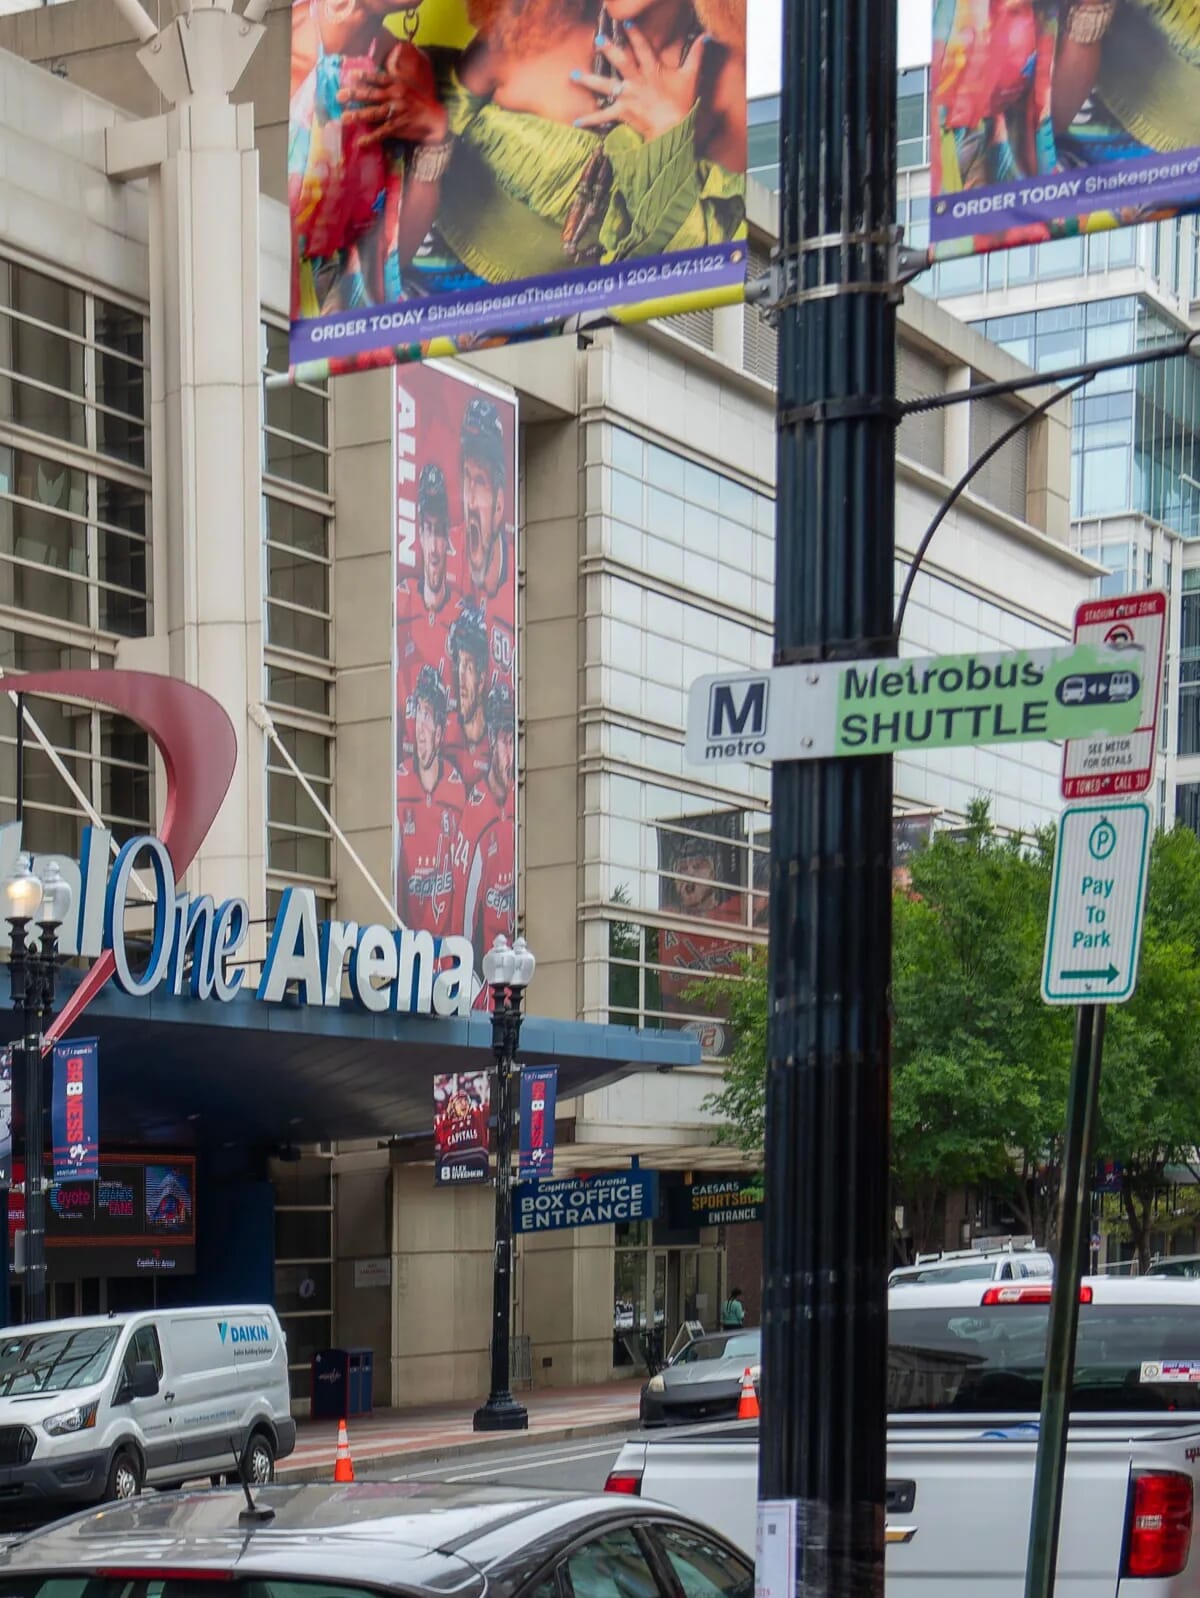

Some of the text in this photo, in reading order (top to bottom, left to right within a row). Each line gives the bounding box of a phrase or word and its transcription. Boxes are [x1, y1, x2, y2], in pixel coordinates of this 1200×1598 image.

[952, 193, 1016, 219] ORDER
[1019, 179, 1081, 205] TODAY
[1084, 156, 1200, 195] Shakespeare
[310, 317, 367, 344] ORDER
[369, 306, 426, 335] TODAY
[426, 275, 615, 324] ShakespeareTheatre.org
[398, 384, 416, 568] ALL IN
[1084, 606, 1115, 622] STADIUM
[843, 658, 1045, 701] Metrobus
[840, 701, 1049, 747] SHUTTLE
[704, 739, 767, 760] metro
[1088, 739, 1131, 755] SEE METER
[1083, 753, 1133, 769] FOR DETAILS
[1065, 781, 1074, 796] IF
[1076, 778, 1101, 795] TOWED
[1114, 775, 1133, 791] CALL
[1081, 876, 1114, 899] Pay
[1086, 905, 1106, 924] To
[1072, 929, 1111, 949] Park
[256, 886, 475, 1017] Arena
[447, 1128, 478, 1146] CAPITALS
[594, 1176, 627, 1188] Arena
[691, 1181, 740, 1196] CAESARS
[521, 1183, 644, 1214] BOX OFFICE
[521, 1200, 643, 1230] ENTRANCE
[708, 1207, 757, 1225] ENTRANCE
[230, 1325, 269, 1343] DAIKIN
